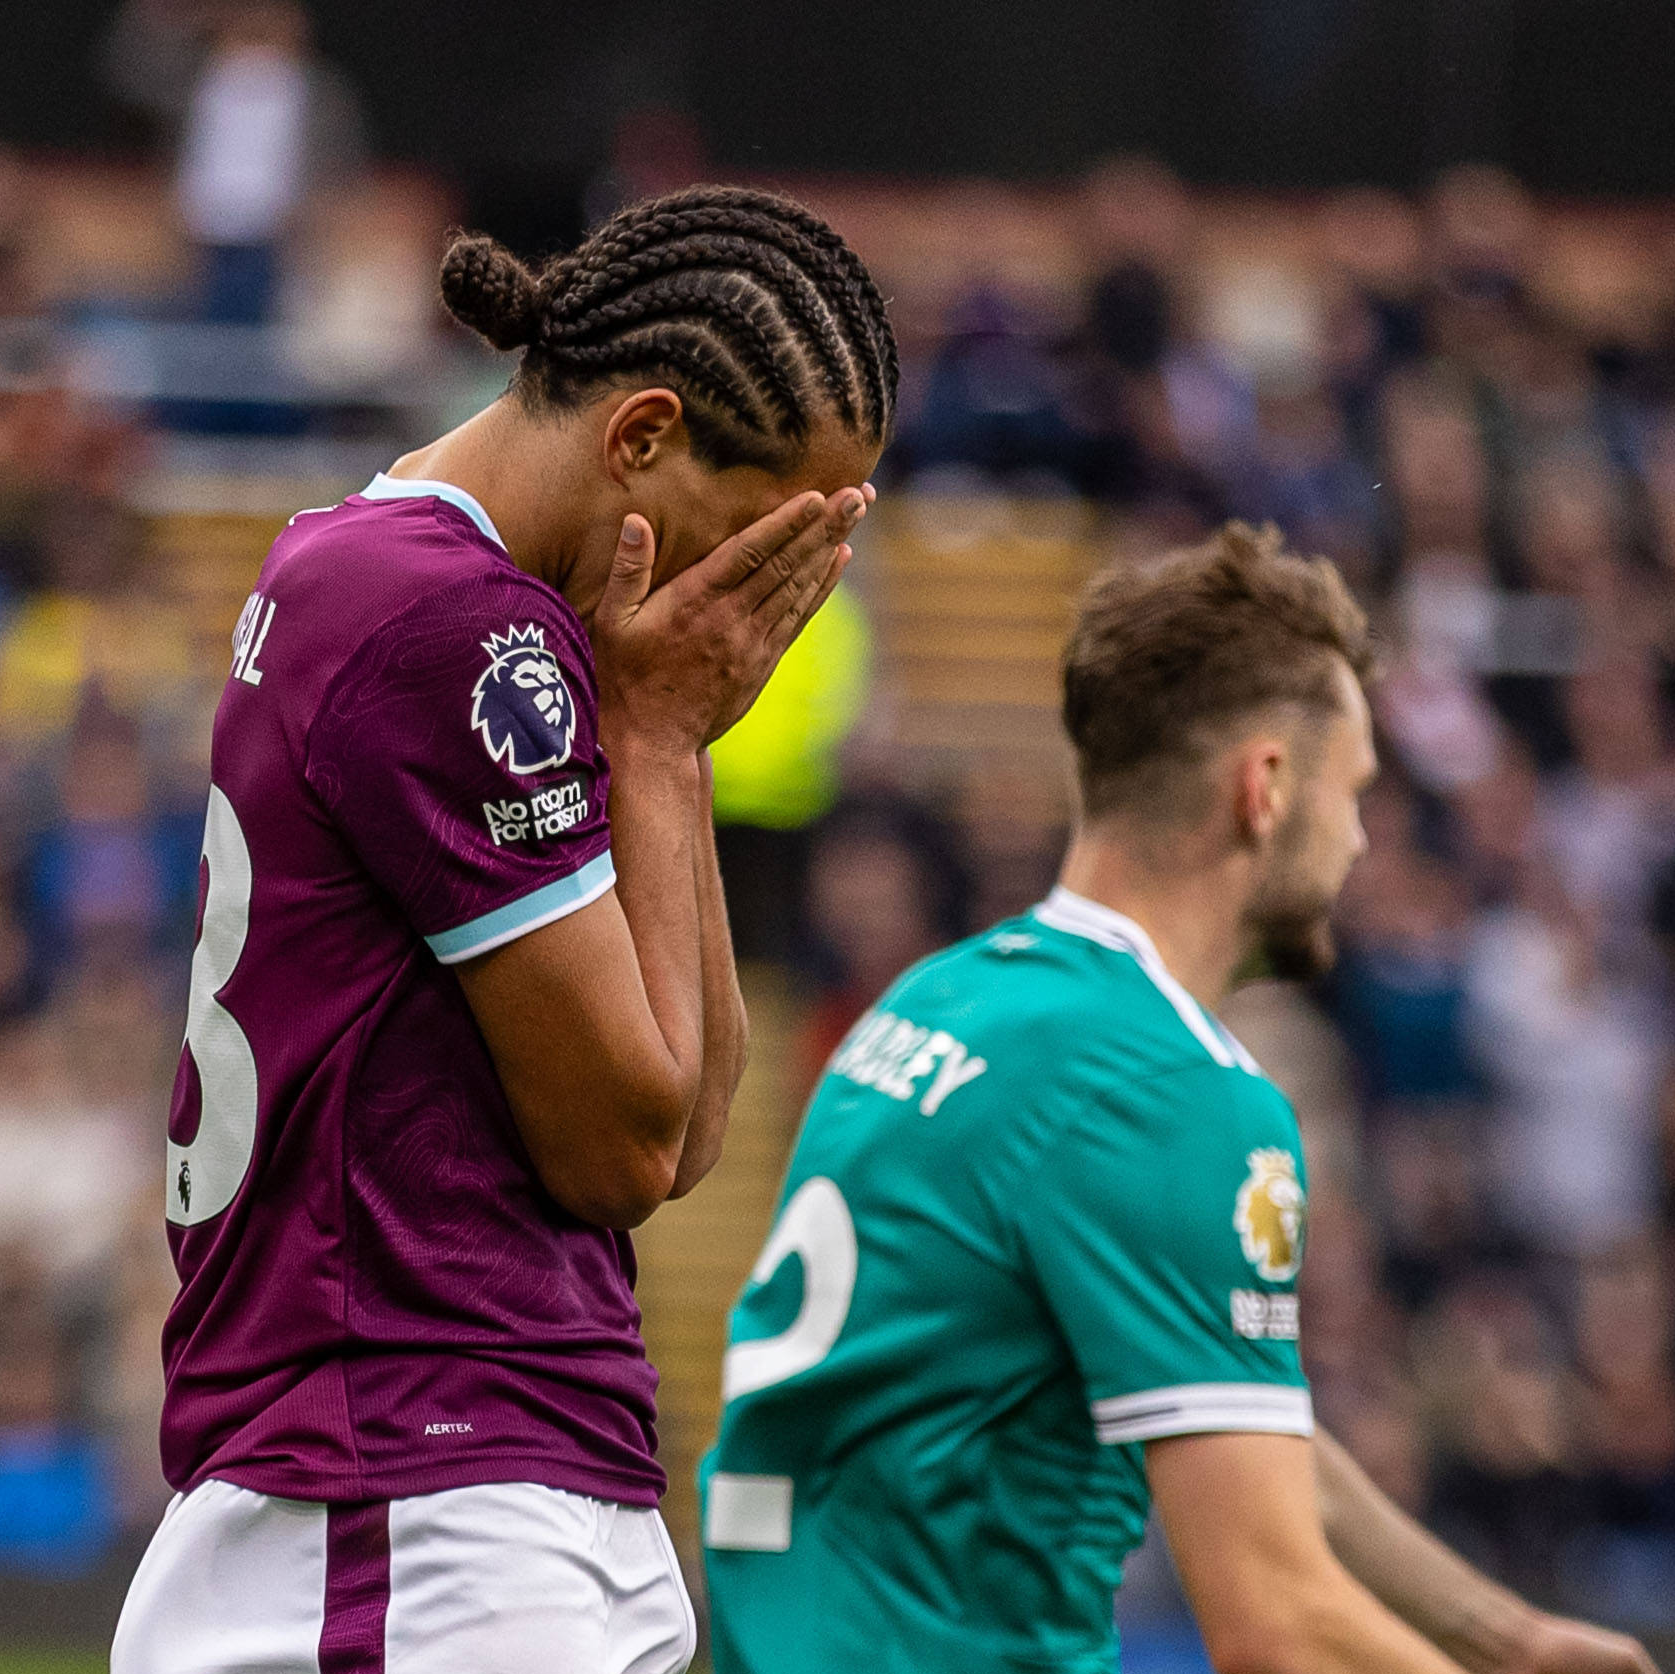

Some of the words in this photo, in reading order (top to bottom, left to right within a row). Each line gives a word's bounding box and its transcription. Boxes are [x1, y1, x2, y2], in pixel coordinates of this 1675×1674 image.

[483, 800, 527, 825] No
[531, 781, 581, 818] room
[490, 821, 530, 846] for
[534, 800, 588, 839] rasm
[424, 1422, 474, 1436] AERTEK
